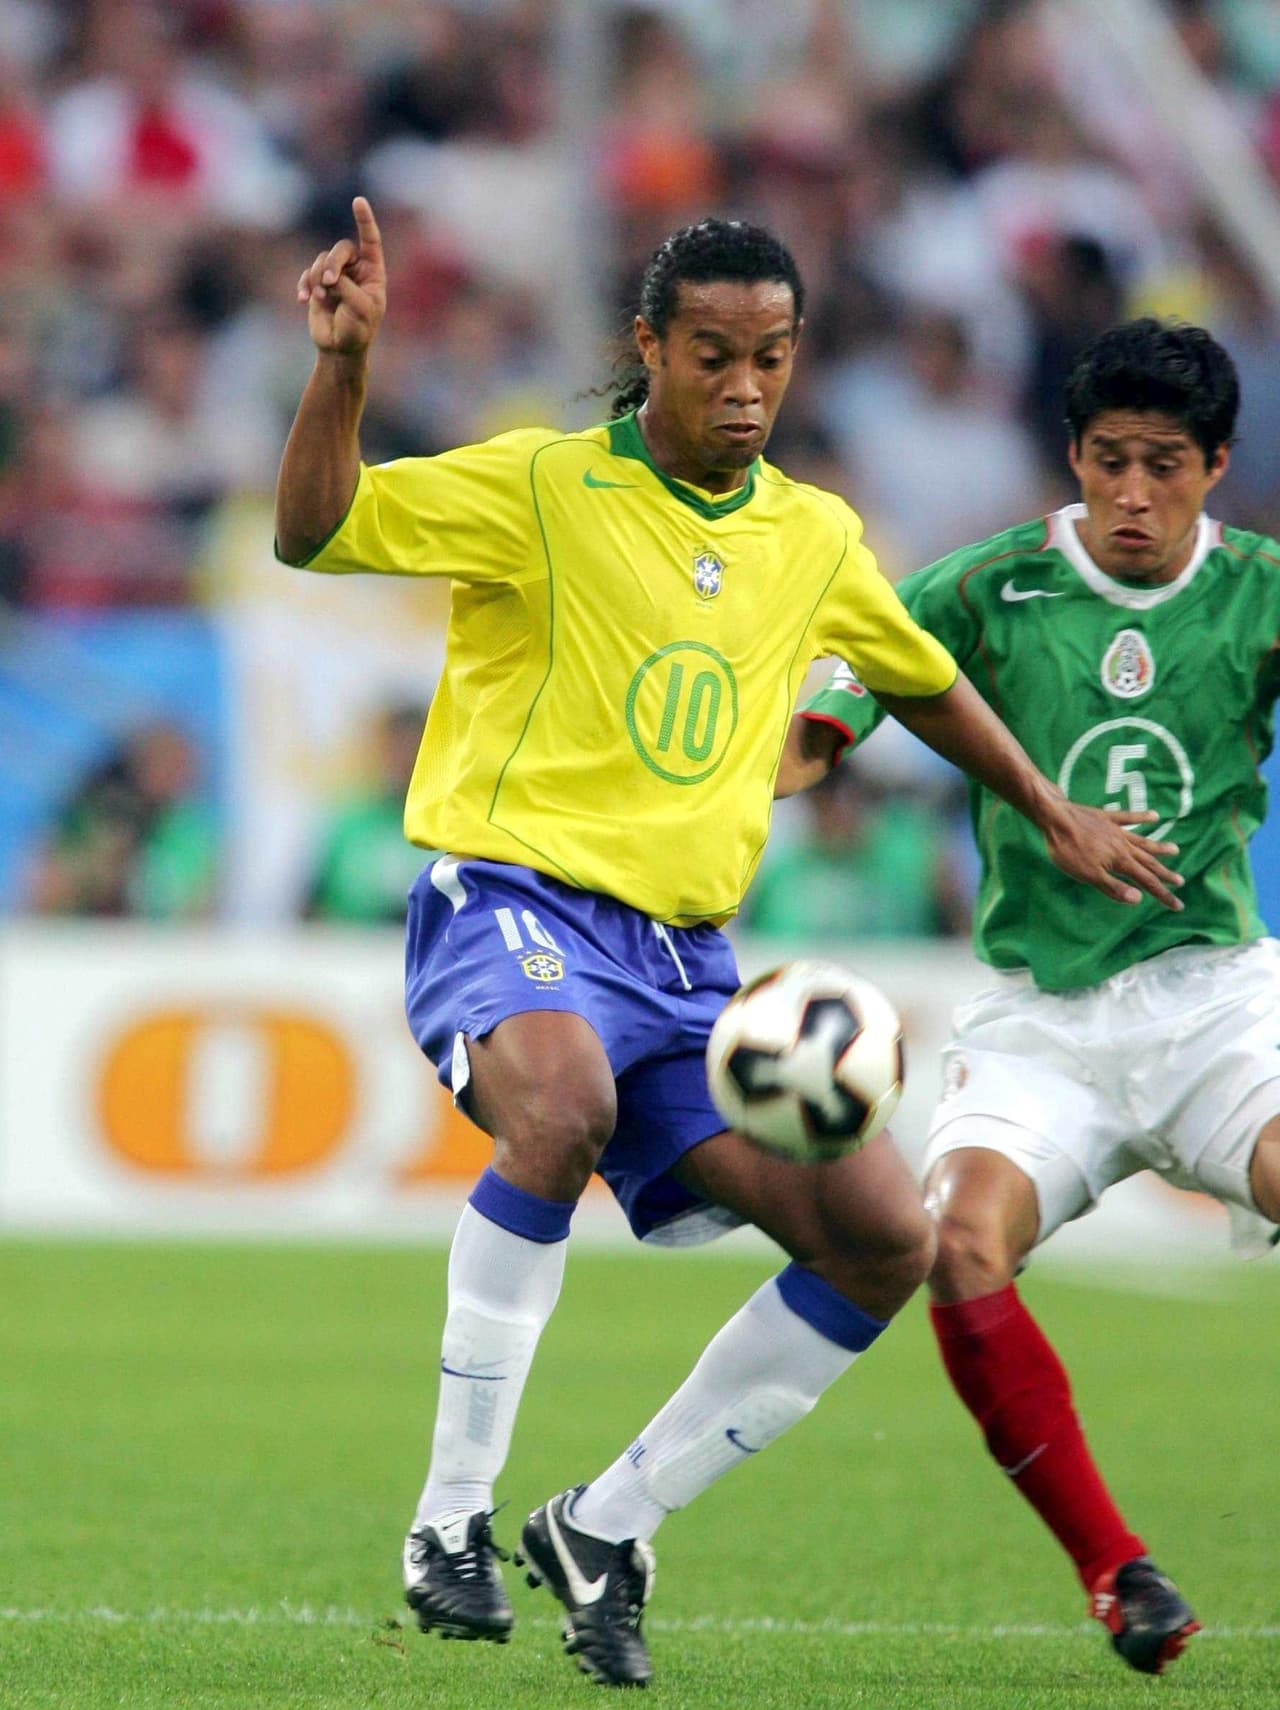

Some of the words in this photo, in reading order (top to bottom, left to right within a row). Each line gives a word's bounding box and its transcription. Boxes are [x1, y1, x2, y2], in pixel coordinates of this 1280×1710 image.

[656, 662, 722, 762] 10
[1102, 743, 1148, 831] 5
[493, 907, 567, 957] 10
